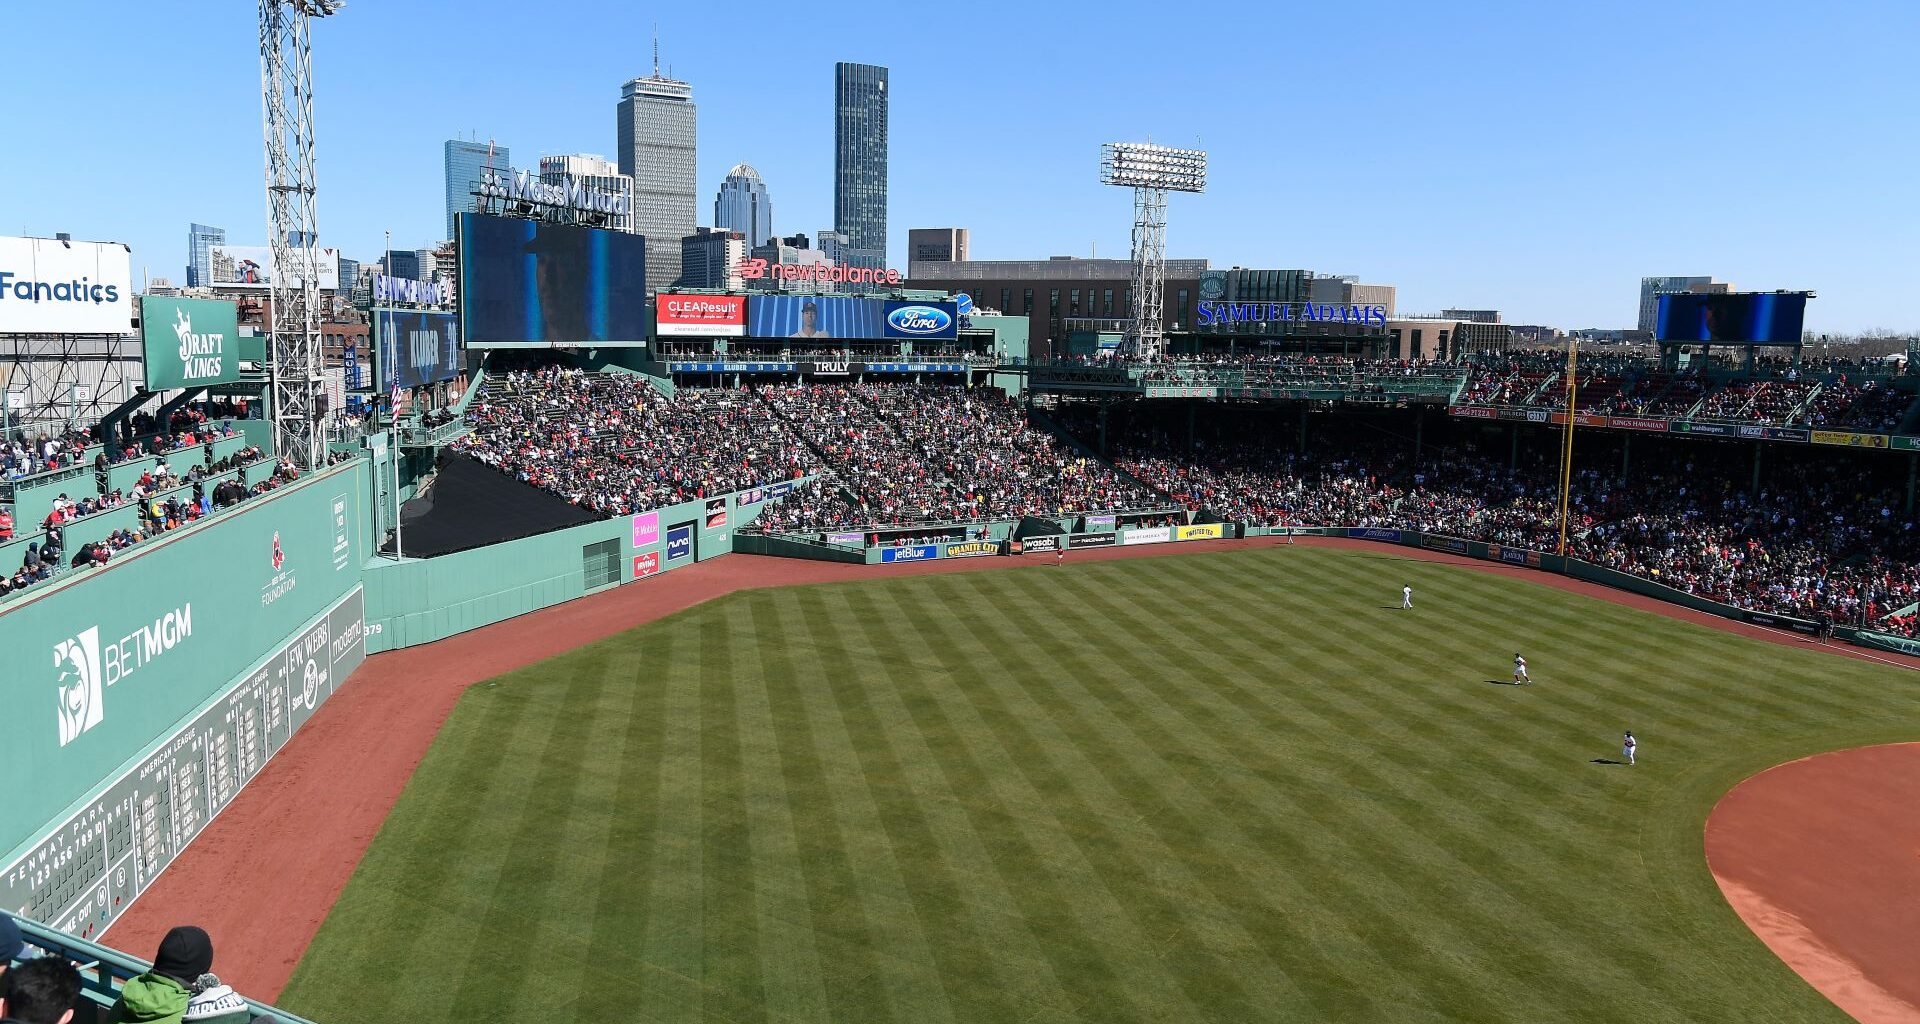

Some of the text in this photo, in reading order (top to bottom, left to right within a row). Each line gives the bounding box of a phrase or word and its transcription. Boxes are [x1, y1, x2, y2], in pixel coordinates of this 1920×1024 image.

[508, 167, 628, 216] MassMutual
[0, 271, 119, 303] Fanatics
[668, 301, 736, 313] CLEAResult
[1197, 300, 1387, 328] SAMUEL ADAMS
[901, 310, 938, 329] Ford
[179, 330, 223, 361] DRAFT
[410, 330, 439, 368] KLUBER
[183, 356, 222, 380] KINGS
[815, 362, 849, 372] TRULY
[1470, 408, 1491, 417] PIZZA
[1528, 412, 1546, 421] GIN
[1741, 427, 1762, 436] WEEI
[707, 506, 726, 516] Safelite
[640, 523, 657, 536] Mobile
[1185, 528, 1213, 537] TWISTED TEA
[668, 537, 690, 549] nuna
[948, 543, 981, 556] GRANITE
[983, 541, 1000, 553] CITY
[1026, 538, 1054, 547] wasabi
[894, 547, 925, 561] jetBlue
[1502, 550, 1523, 561] KAYEM
[637, 558, 655, 570] IRVING
[262, 576, 296, 608] FOUNDATION
[1752, 616, 1774, 624] Aspiration
[364, 623, 382, 636] 379
[105, 602, 192, 687] BETMGM
[305, 623, 328, 659] WEBB
[333, 618, 361, 658] moderna
[229, 683, 251, 707] NATIONAL
[252, 668, 269, 688] LEAGUE
[140, 727, 196, 781] AMERICAN LEAGUE
[181, 763, 191, 778] CLE
[181, 776, 191, 790] SEA
[134, 790, 139, 802] P
[144, 795, 154, 809] PHI
[107, 799, 128, 824] R H E
[145, 809, 155, 824] TEX
[95, 822, 102, 835] 10
[145, 821, 156, 836] DET
[183, 823, 194, 840] HOU
[9, 802, 105, 888] FENWAY PARK
[147, 834, 155, 848] TB
[148, 848, 155, 862] SF
[147, 859, 158, 878] NYY
[60, 901, 92, 935] RIKE OUT
